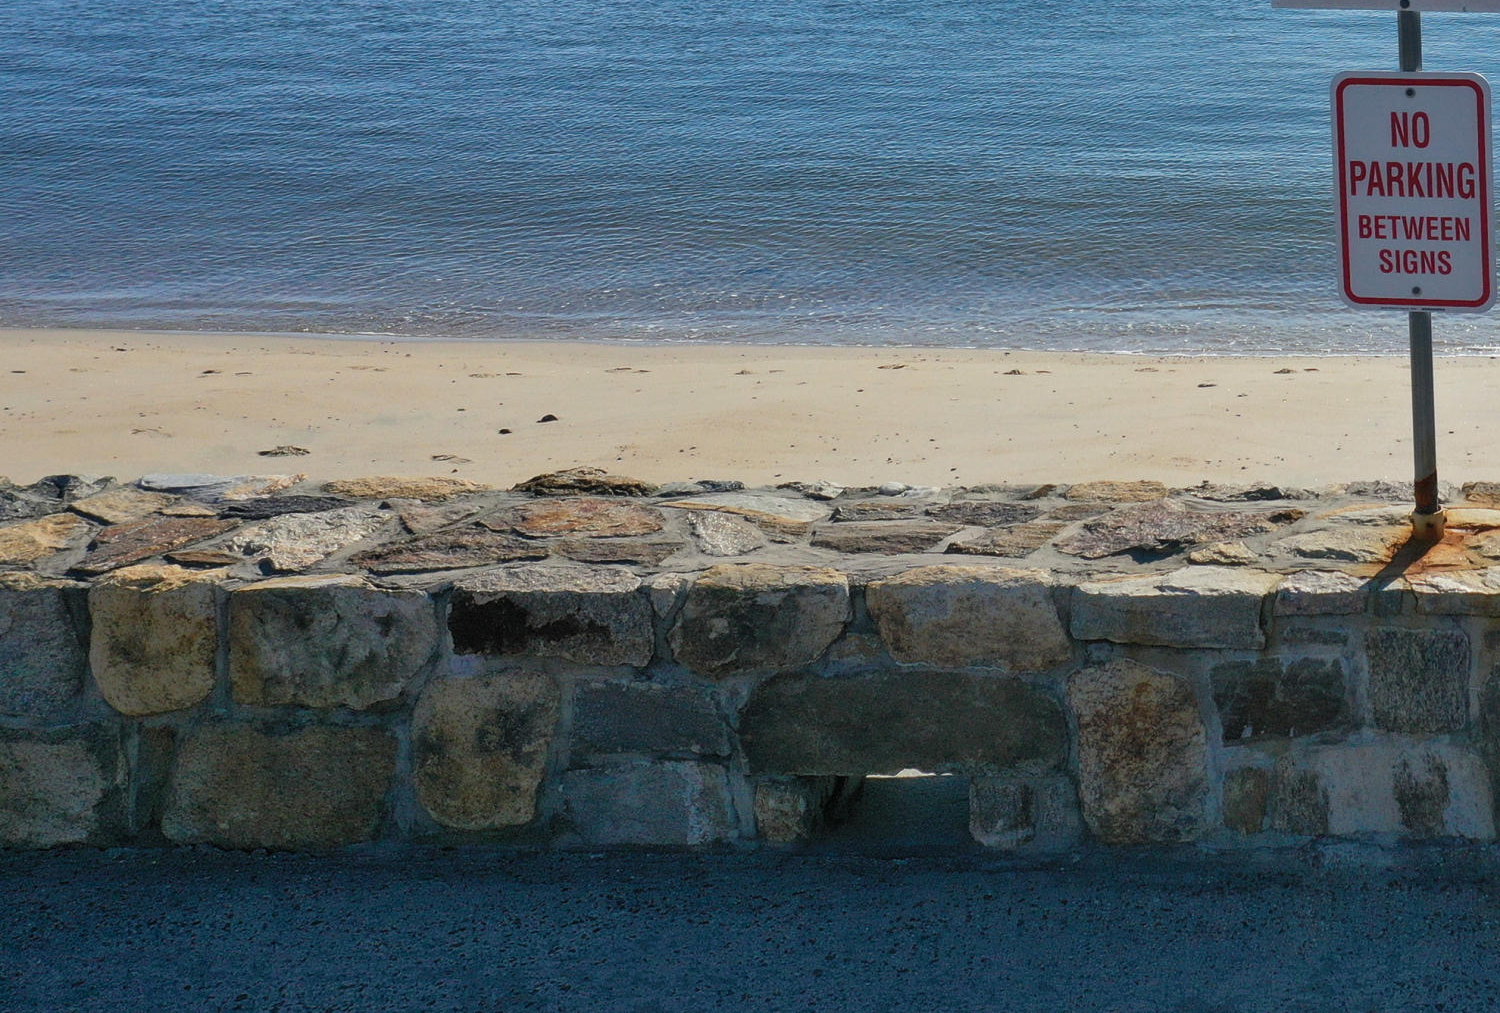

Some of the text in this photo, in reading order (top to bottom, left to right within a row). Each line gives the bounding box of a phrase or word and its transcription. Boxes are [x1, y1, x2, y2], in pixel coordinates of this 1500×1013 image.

[1390, 111, 1430, 148] NO
[1349, 161, 1475, 199] PARKING
[1359, 215, 1470, 241] BETWEEN
[1379, 249, 1452, 275] SIGNS
